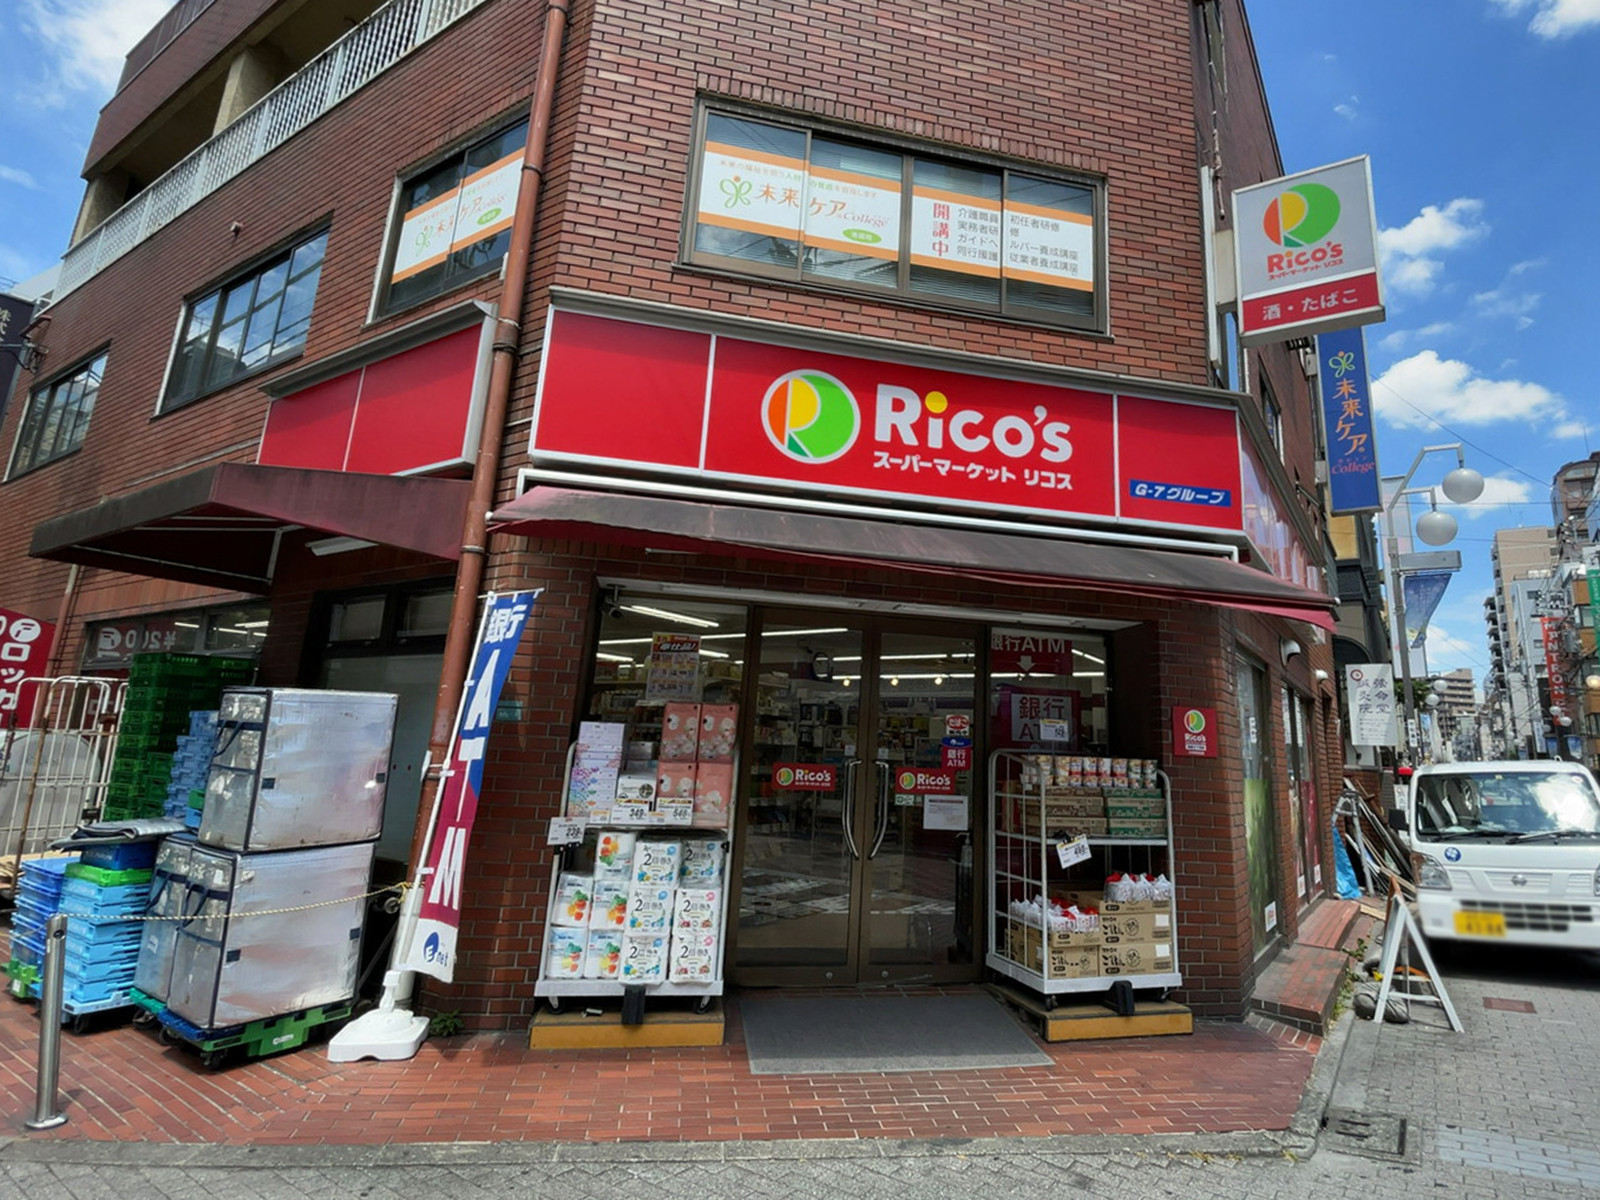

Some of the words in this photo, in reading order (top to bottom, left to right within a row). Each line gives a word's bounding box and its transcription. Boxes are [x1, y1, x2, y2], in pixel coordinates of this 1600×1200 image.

[754, 183, 847, 217] 未来ケア
[932, 203, 950, 256] 開講中
[874, 383, 1073, 462] Rico's
[1332, 378, 1368, 456] 未来ケア
[873, 450, 1016, 484] スーパーマーケット
[1023, 468, 1073, 490] リコス
[1331, 460, 1375, 475] College
[1020, 696, 1065, 719] 銀行
[428, 649, 499, 911] ATM
[795, 768, 831, 782] Rico's
[917, 773, 951, 786] Rico's
